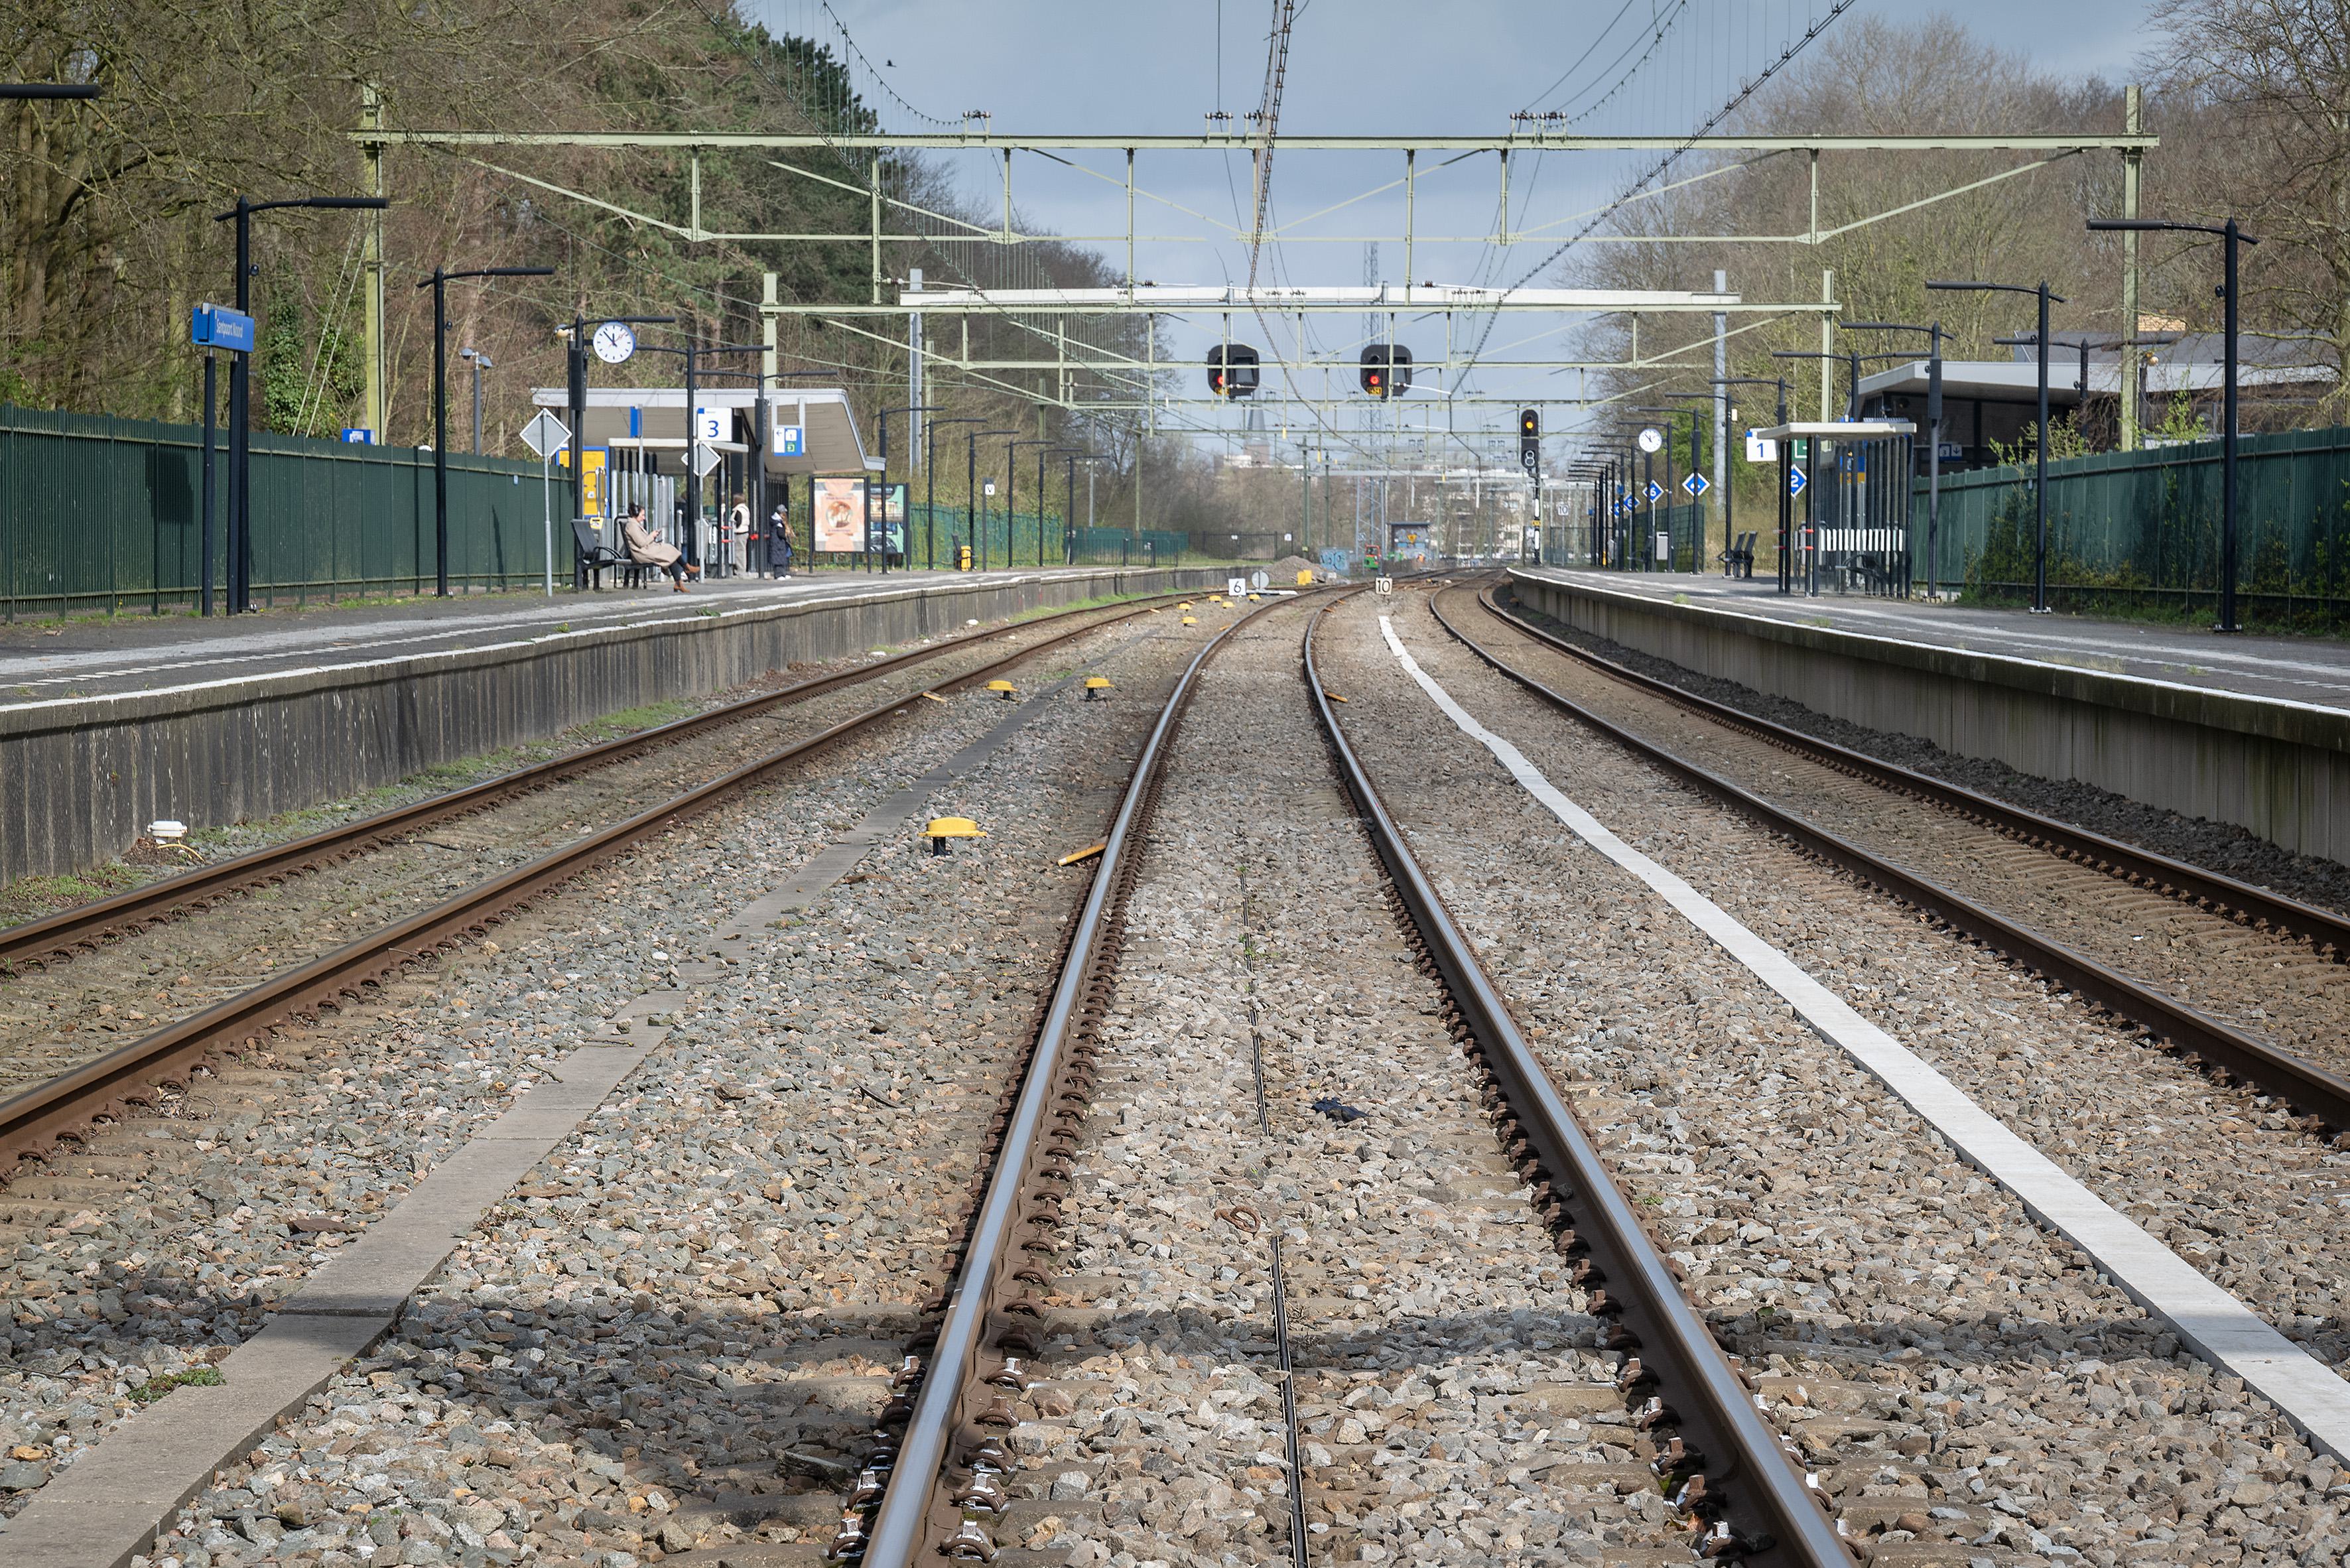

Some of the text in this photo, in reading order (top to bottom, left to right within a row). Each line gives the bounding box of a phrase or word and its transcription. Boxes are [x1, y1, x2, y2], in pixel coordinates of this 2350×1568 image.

[216, 318, 243, 338] Santpoort Noord
[708, 421, 718, 437] 3
[1756, 442, 1764, 458] 1
[1791, 474, 1799, 488] 2
[1650, 487, 1656, 497] 6
[1559, 505, 1568, 514] 10
[1234, 580, 1241, 593] 6
[1378, 580, 1390, 592] 10
